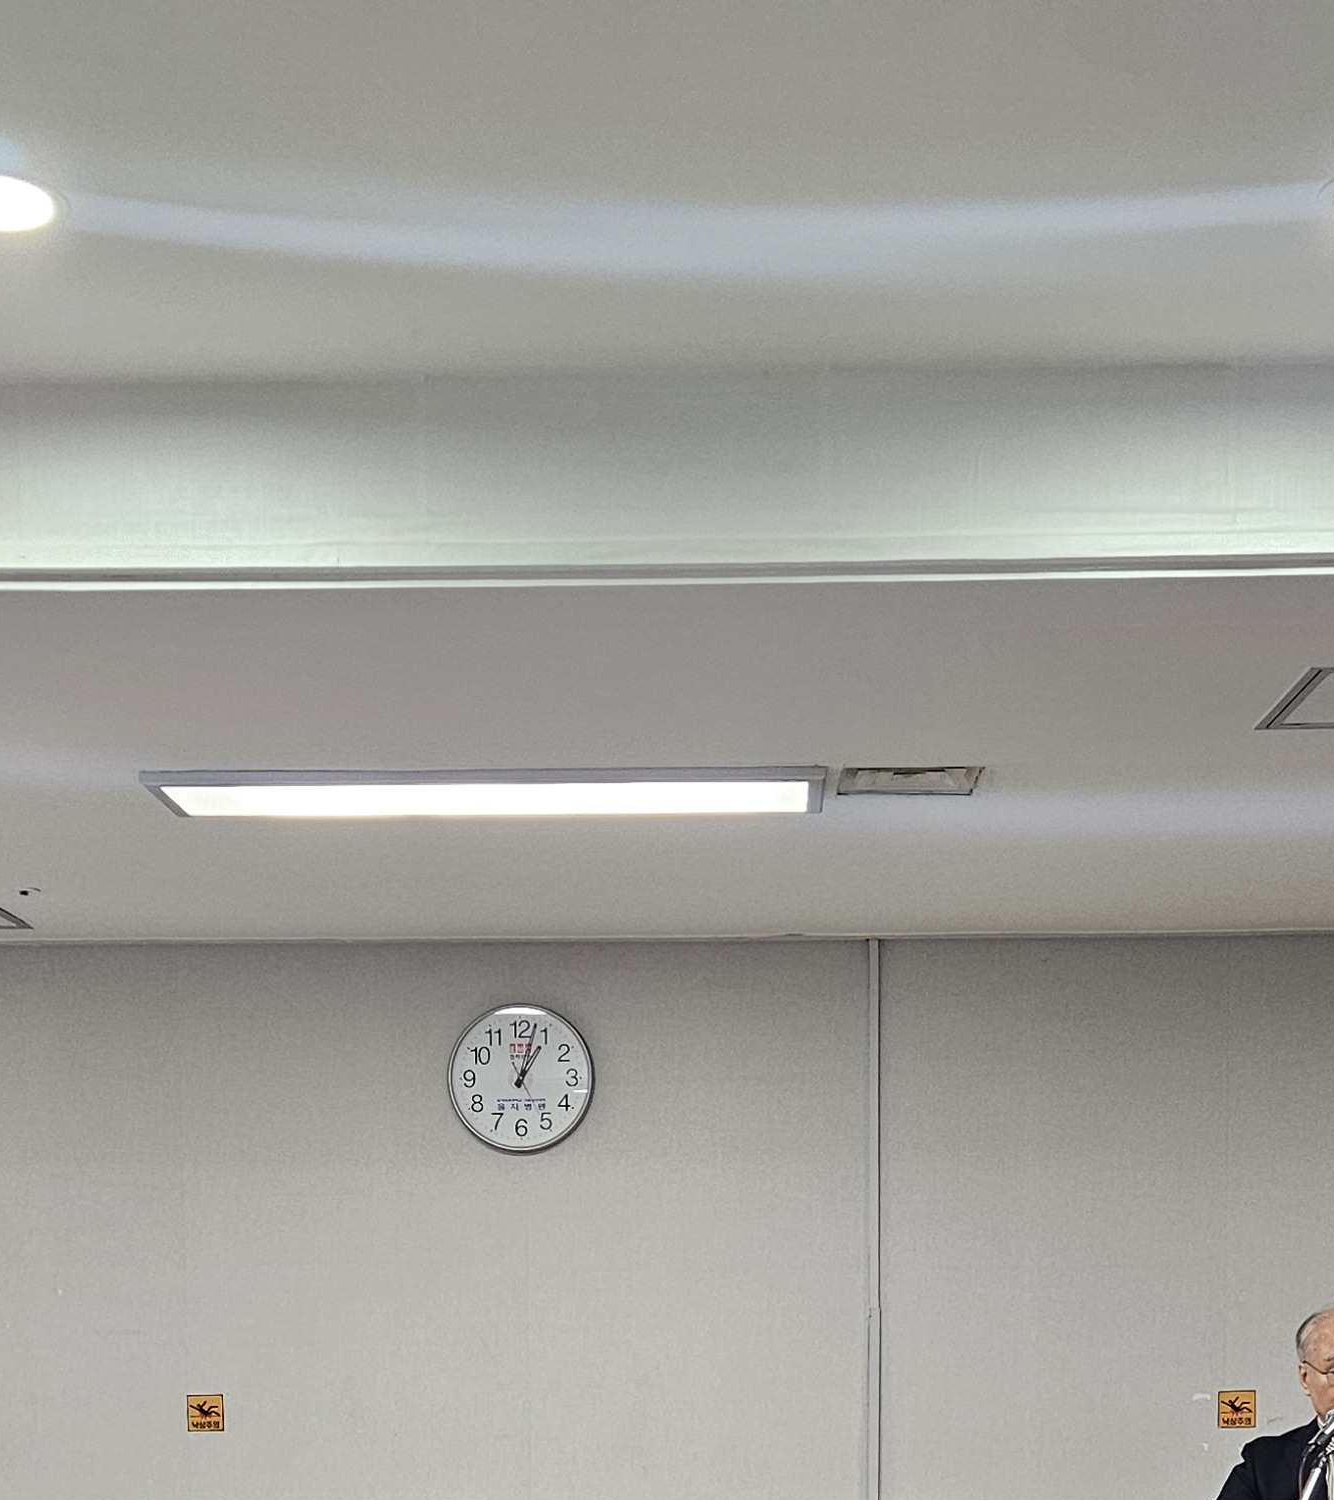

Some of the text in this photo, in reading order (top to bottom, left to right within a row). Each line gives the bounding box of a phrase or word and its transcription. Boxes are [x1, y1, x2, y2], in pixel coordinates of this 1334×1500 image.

[485, 1028, 502, 1046] 11
[509, 1019, 531, 1039] 12
[540, 1027, 548, 1045] 1
[470, 1046, 491, 1065] 10
[557, 1044, 571, 1062] 2
[462, 1069, 476, 1088] 9
[565, 1068, 579, 1087] 3
[470, 1094, 484, 1113] 8
[557, 1094, 571, 1111] 4
[491, 1112, 504, 1130] 7
[514, 1118, 528, 1137] 6
[539, 1112, 553, 1130] 5
[191, 1420, 220, 1429] 낙상주의
[1222, 1417, 1252, 1426] 낙상주의
